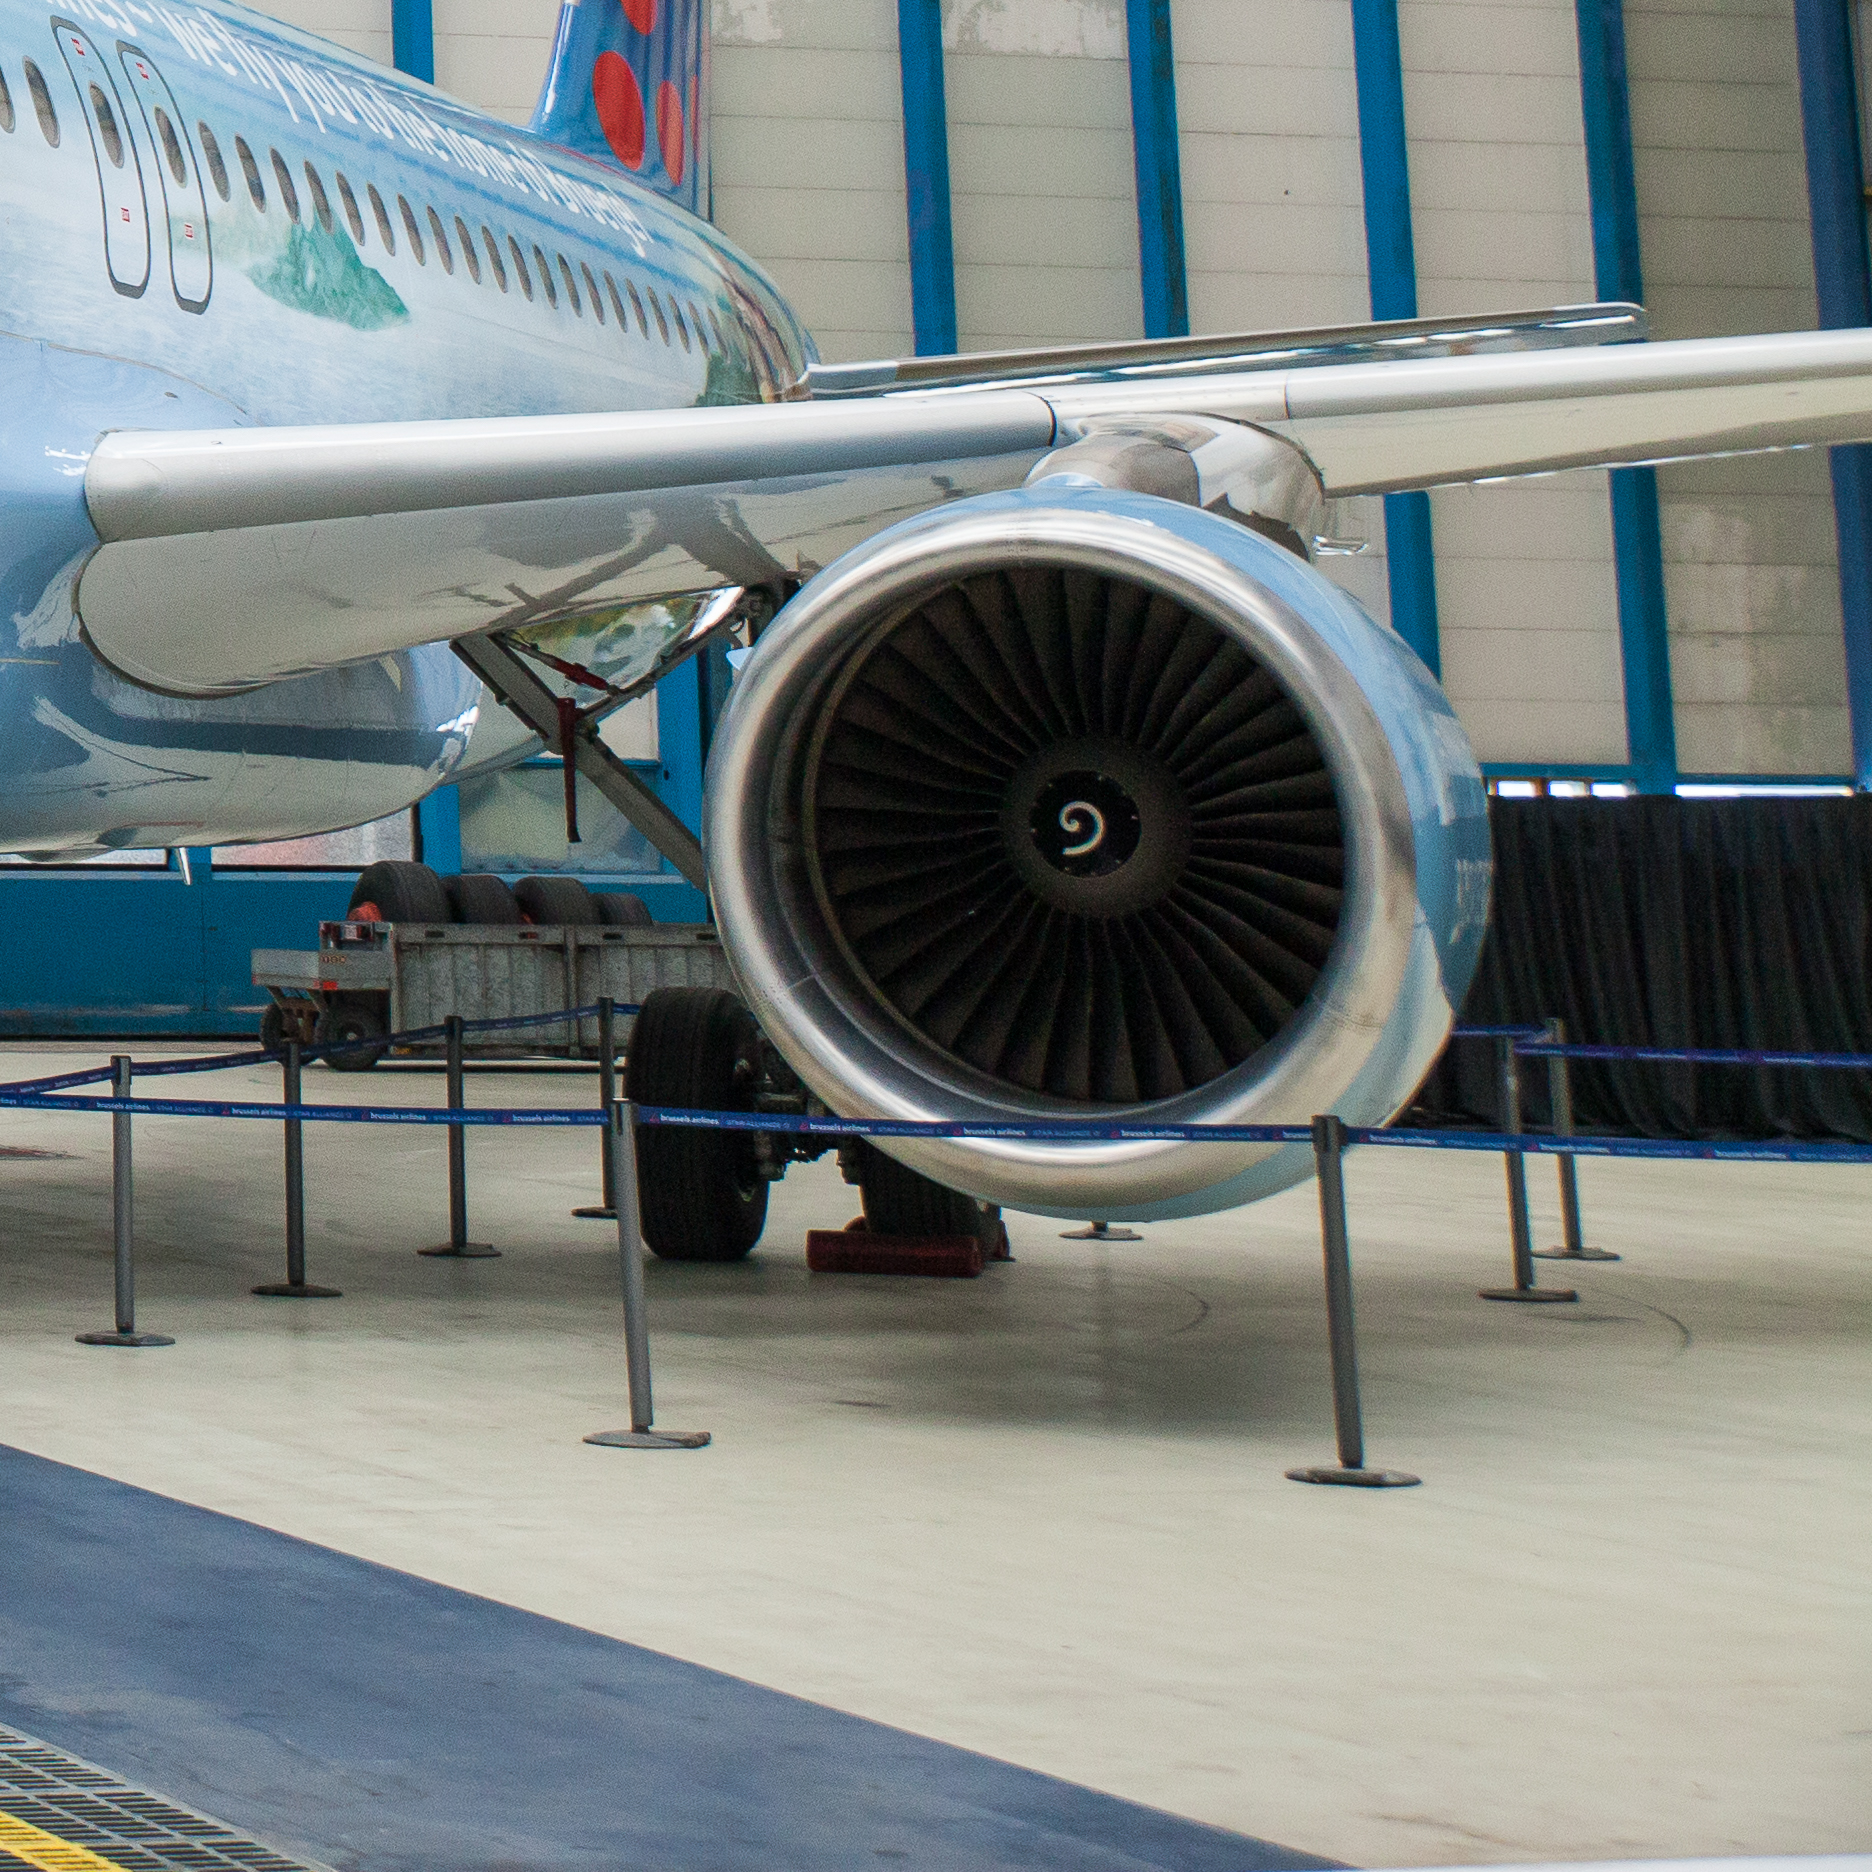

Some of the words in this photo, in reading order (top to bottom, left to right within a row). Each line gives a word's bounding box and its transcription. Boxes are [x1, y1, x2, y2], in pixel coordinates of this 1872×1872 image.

[145, 0, 238, 77] we
[195, 7, 299, 123] fly
[260, 48, 359, 134] you
[323, 69, 390, 139] to
[361, 76, 446, 161] the
[406, 98, 526, 193] home
[504, 140, 560, 206] of
[231, 1107, 259, 1116] brussels
[260, 1108, 286, 1117] airlines
[370, 1111, 399, 1120] brussels
[400, 1112, 427, 1121] airlines
[512, 1114, 542, 1122] brussels
[543, 1114, 571, 1123] airlines
